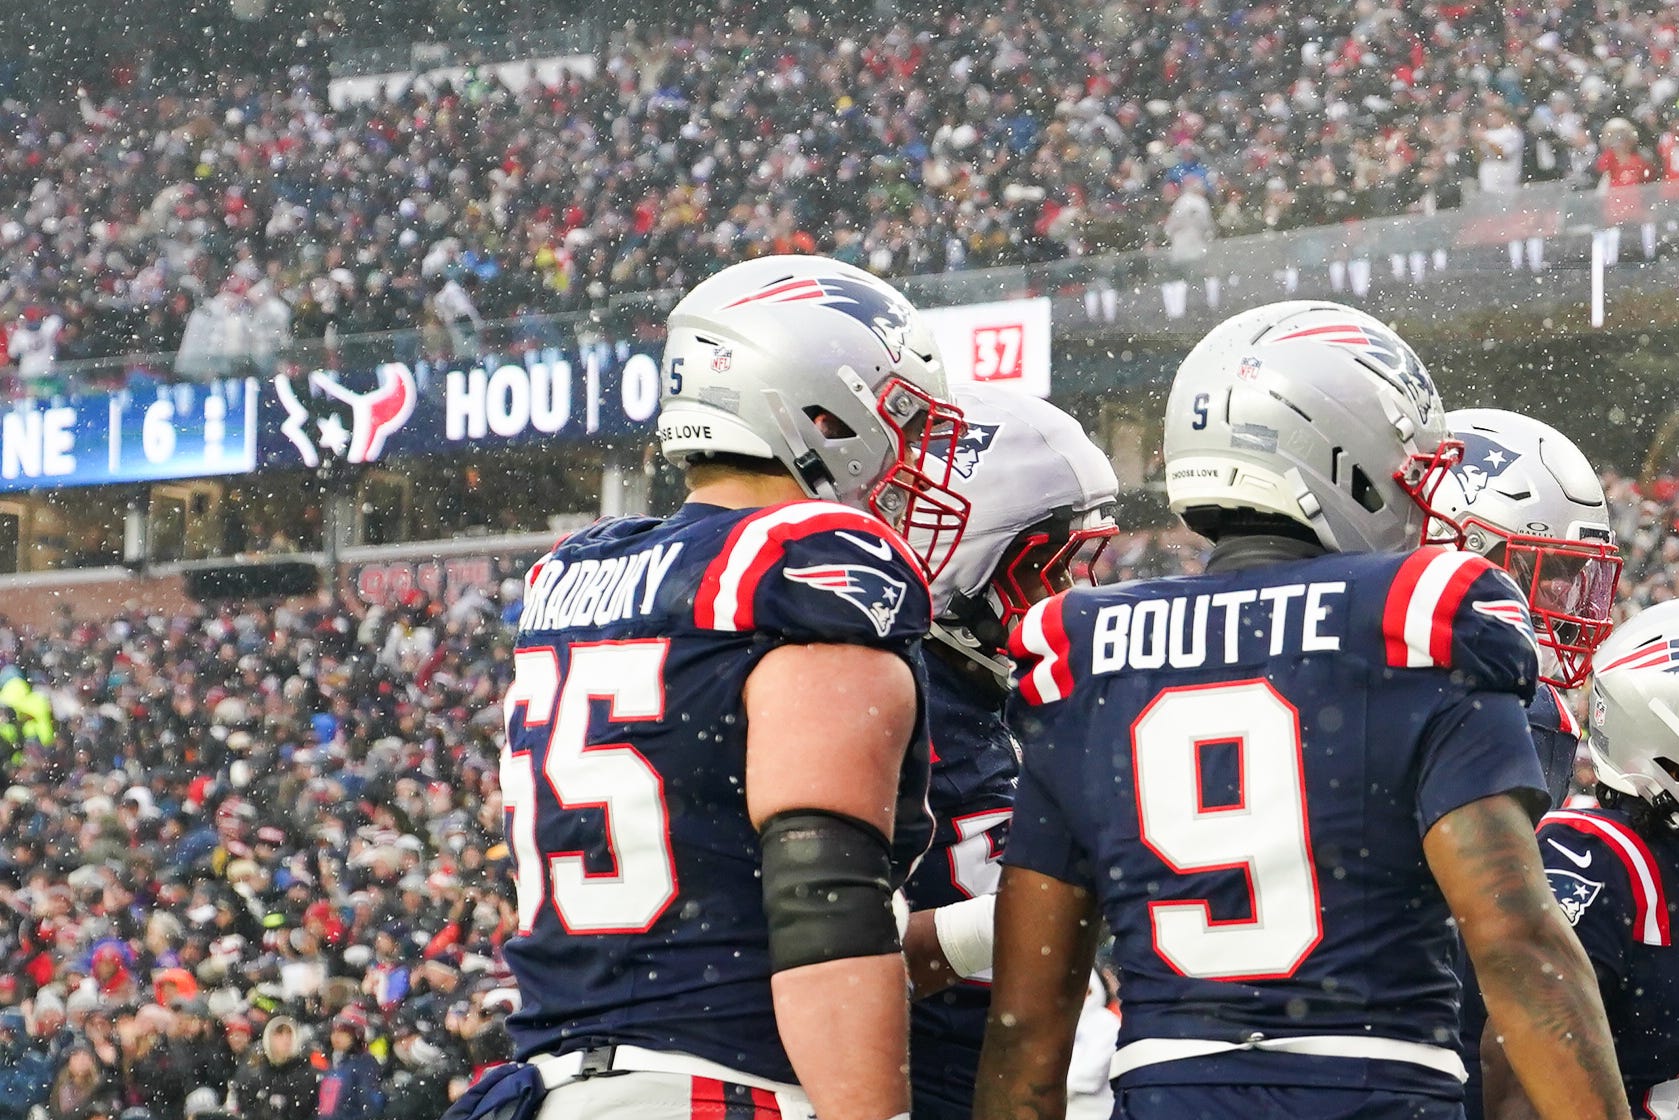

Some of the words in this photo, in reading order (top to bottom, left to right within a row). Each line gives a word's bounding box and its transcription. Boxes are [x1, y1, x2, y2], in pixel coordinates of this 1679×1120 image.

[975, 327, 1021, 378] 37
[446, 359, 572, 441] HOU
[621, 353, 660, 421] 0
[675, 425, 712, 439] LOVE
[2, 406, 78, 479] NE
[142, 399, 177, 464] 6
[1197, 468, 1219, 478] LOVE
[1092, 581, 1346, 675] BOUTTE
[1130, 677, 1325, 982] 9
